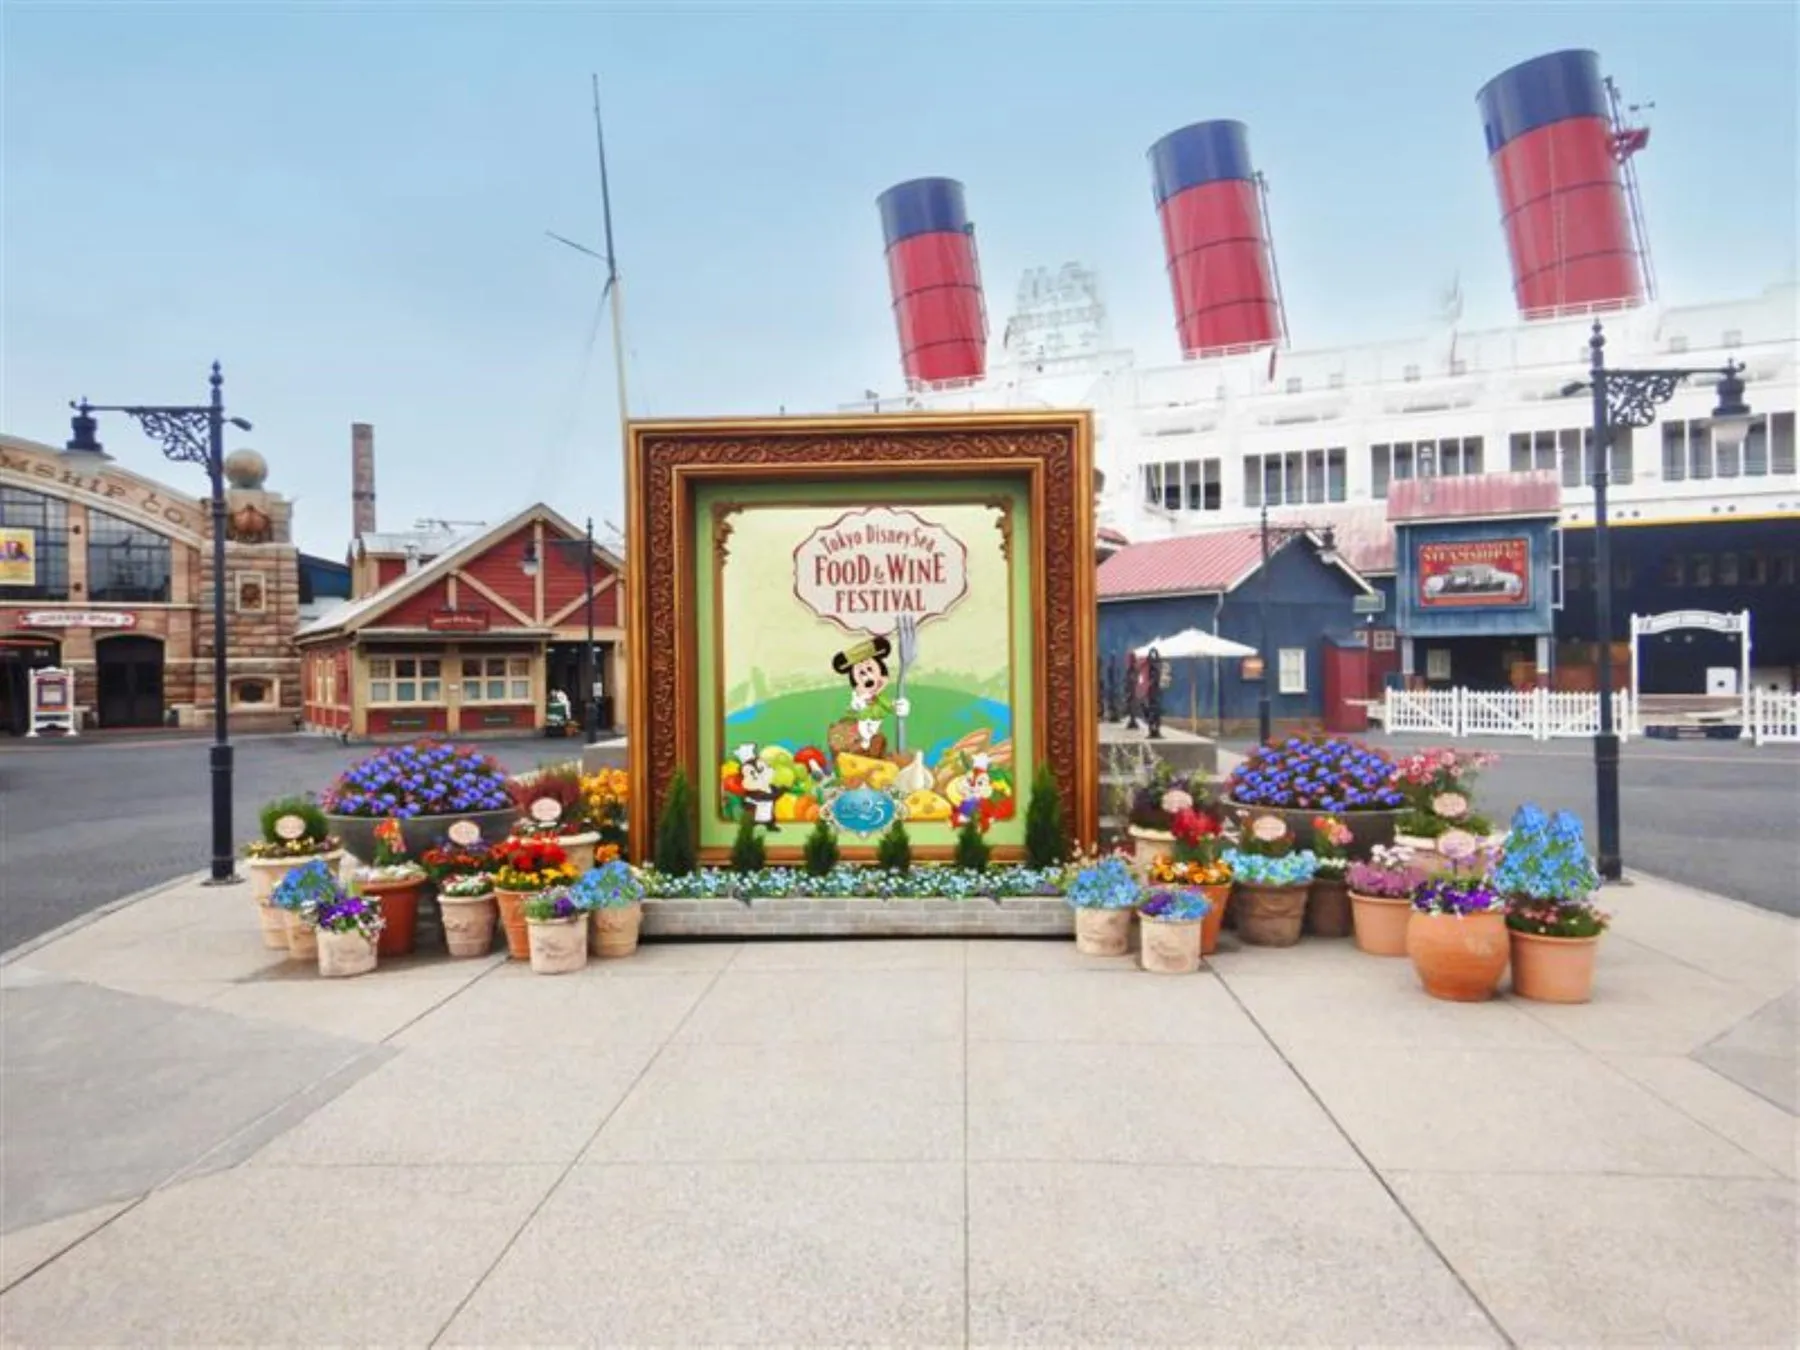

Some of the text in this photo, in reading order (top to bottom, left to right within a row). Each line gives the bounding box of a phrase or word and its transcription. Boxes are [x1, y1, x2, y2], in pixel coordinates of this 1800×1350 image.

[819, 524, 936, 554] Tokyo DisneySea
[814, 552, 947, 586] FOOD & WINE
[835, 588, 927, 613] FESTIVAL
